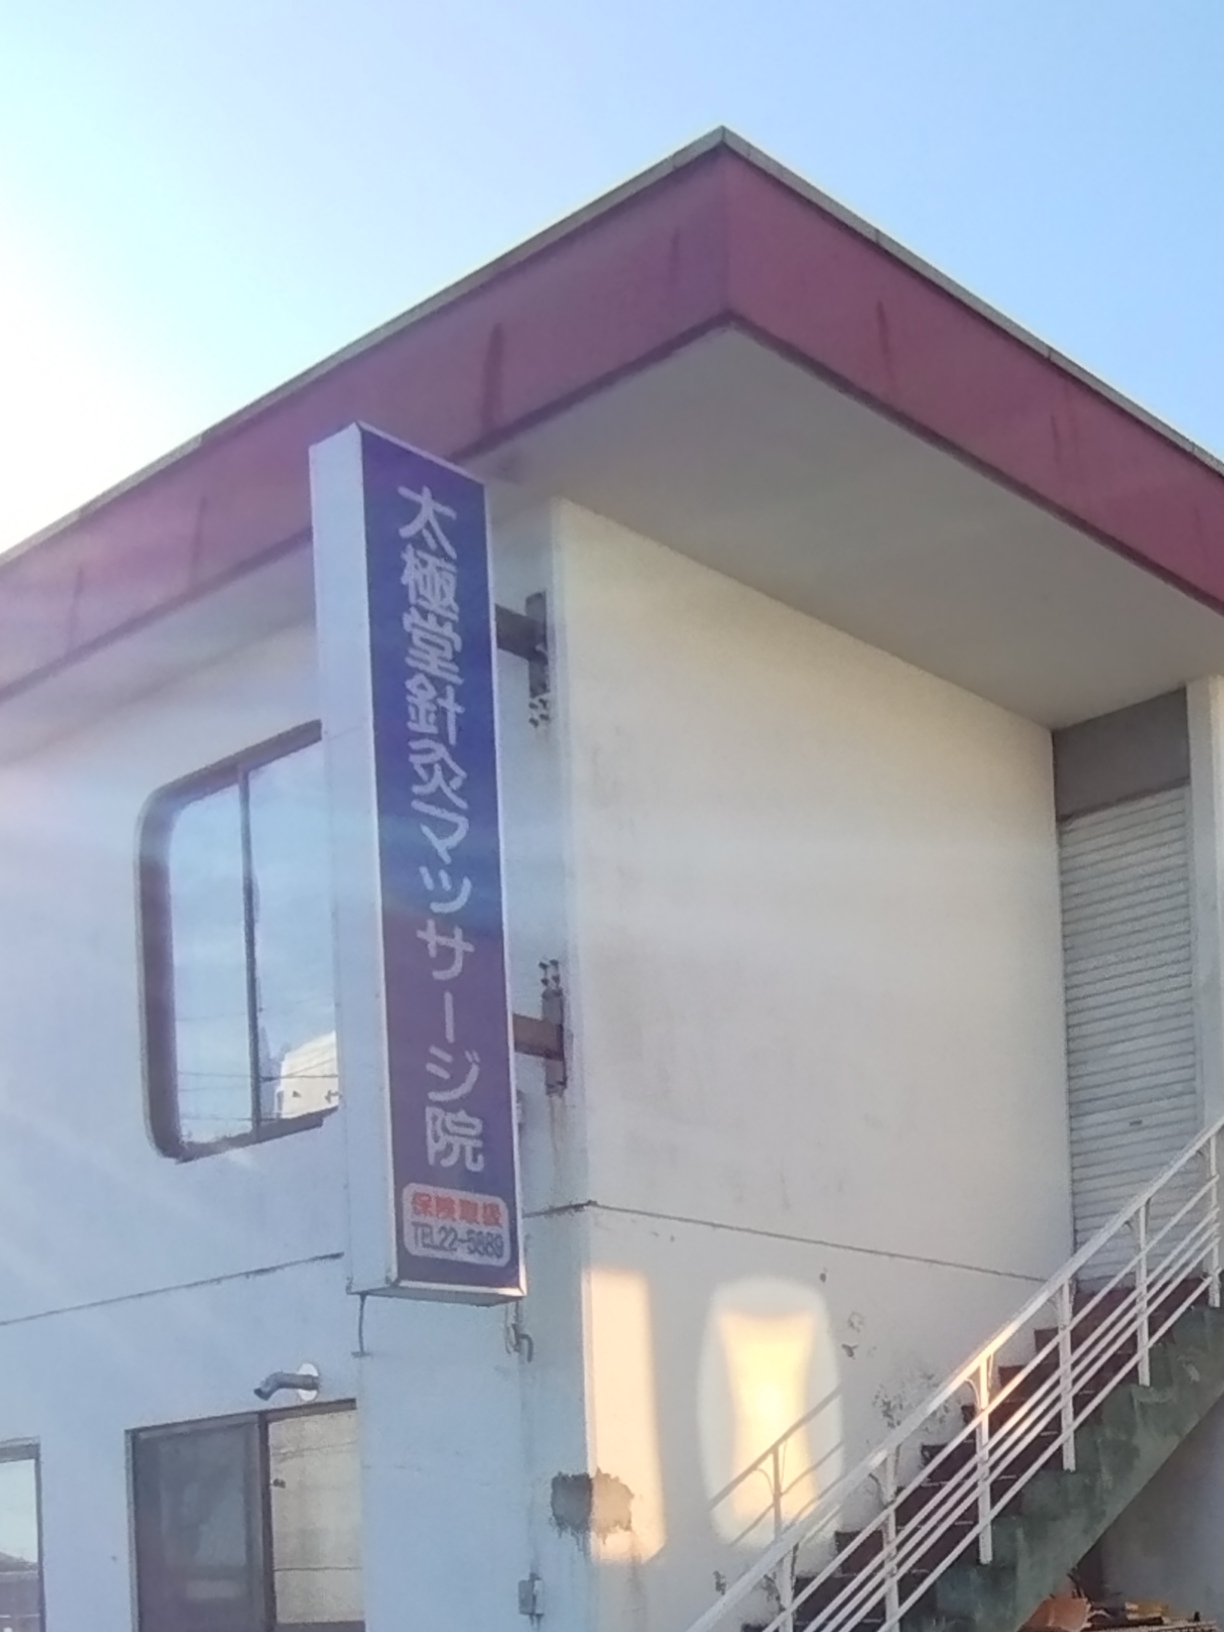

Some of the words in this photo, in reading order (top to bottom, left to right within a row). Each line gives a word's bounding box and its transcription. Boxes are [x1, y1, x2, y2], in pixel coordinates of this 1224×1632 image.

[398, 485, 485, 1172] 太極堂針灸マッサージ院
